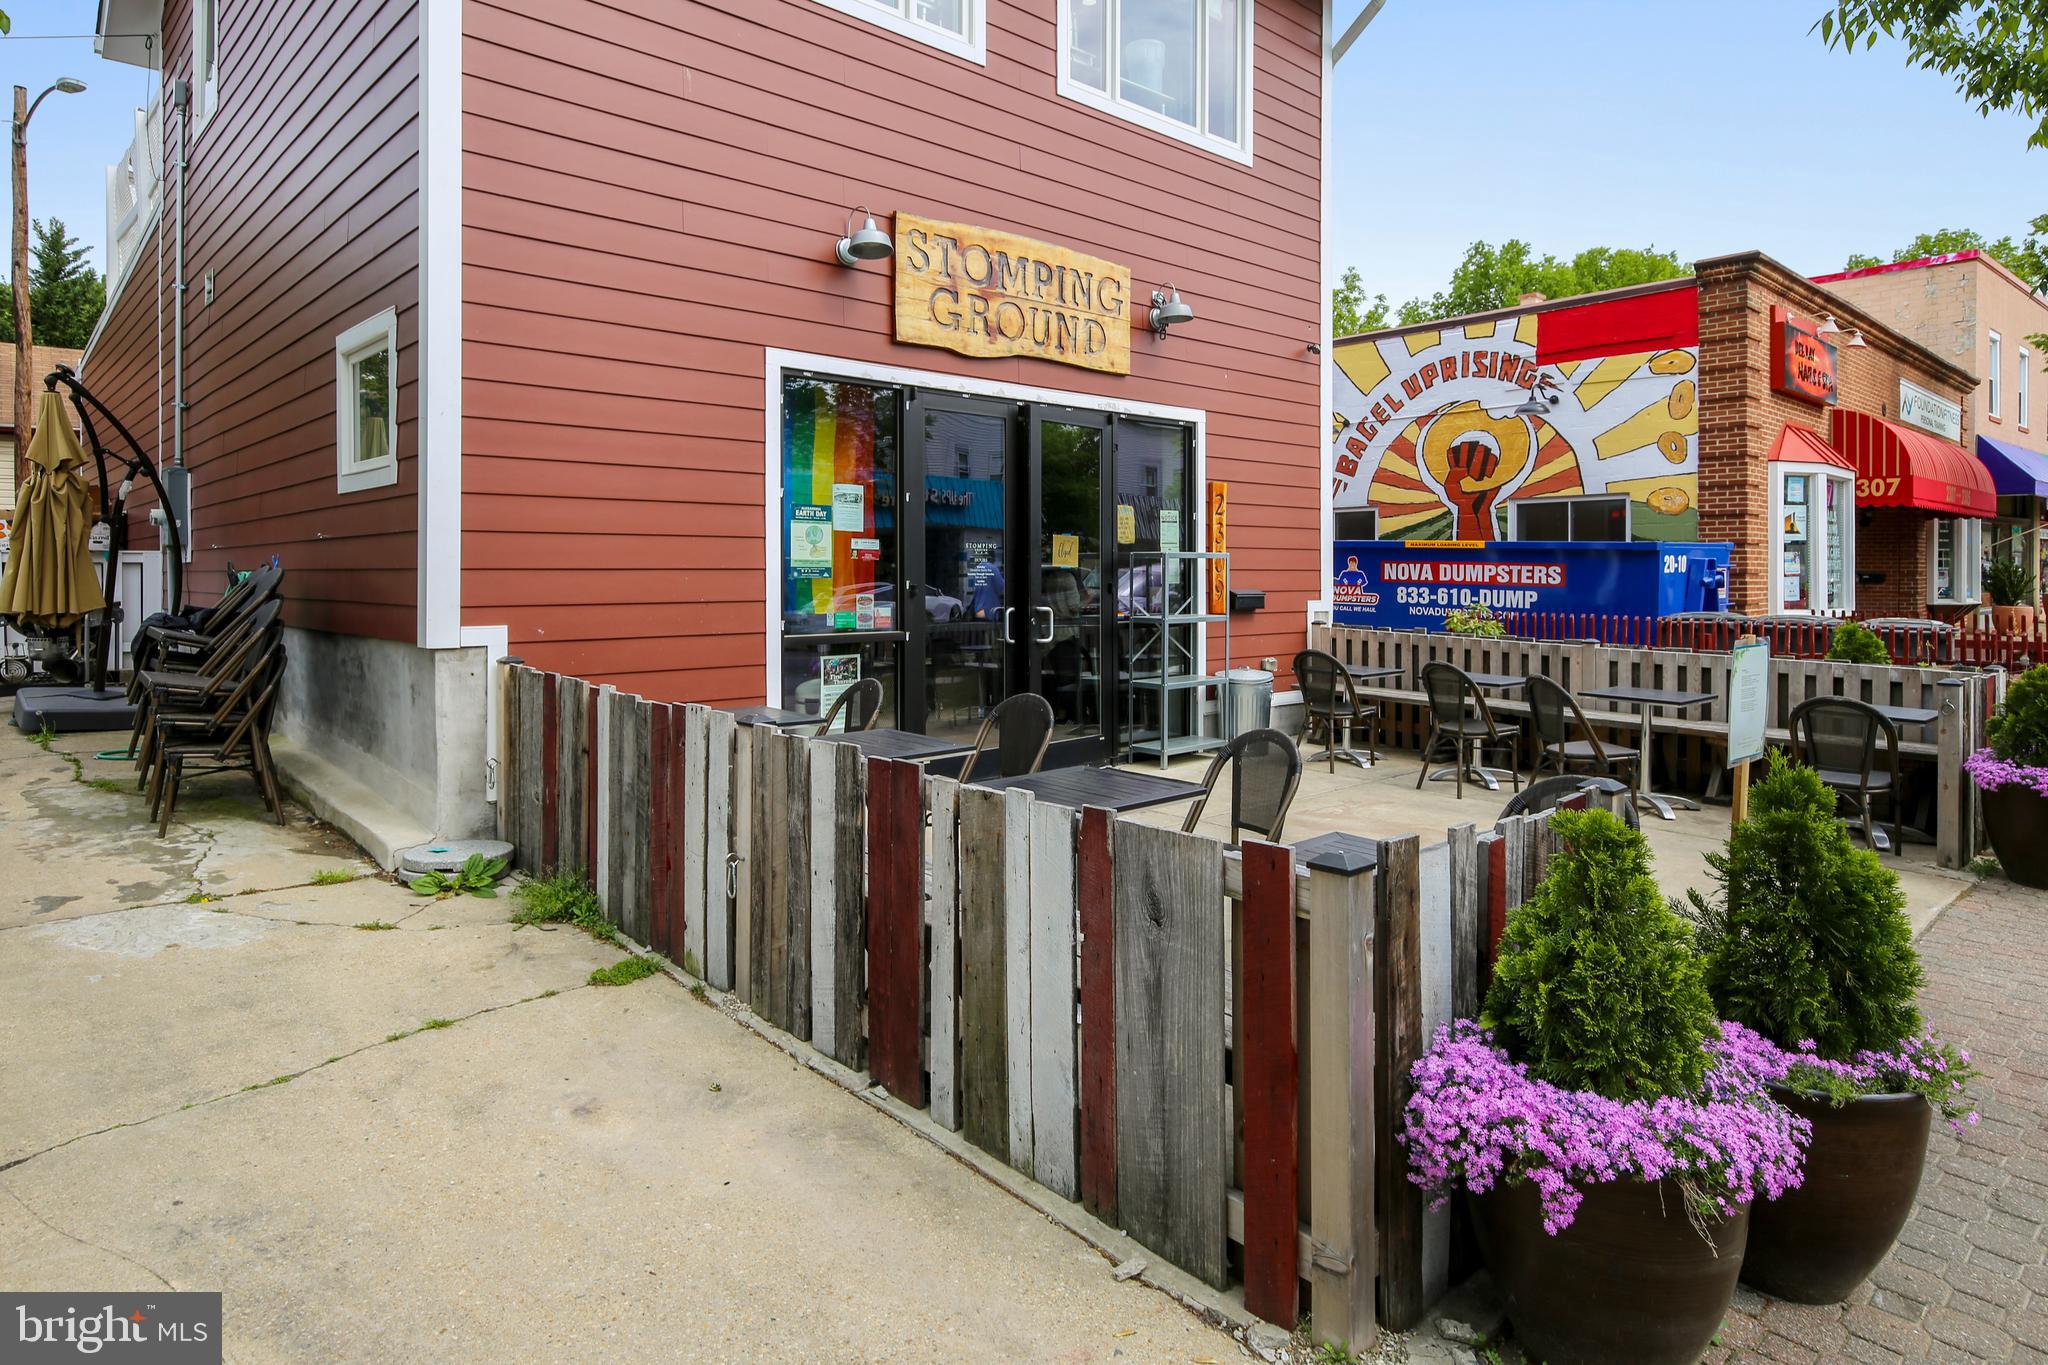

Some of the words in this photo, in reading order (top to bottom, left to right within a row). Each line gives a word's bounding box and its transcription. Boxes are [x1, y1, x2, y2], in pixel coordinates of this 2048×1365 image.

[906, 228, 1124, 315] STOMPING
[930, 288, 1107, 355] GROUND
[1335, 394, 1404, 477] BAGEL
[1400, 350, 1539, 400] UPRISING
[795, 509, 815, 517] EARTH
[1384, 563, 1434, 581] NOVA
[1439, 563, 1562, 585] DUMPSTERS
[1664, 554, 1687, 573] 20-10
[1333, 585, 1361, 594] NOVA
[1396, 586, 1538, 609] 833-610-DUMP
